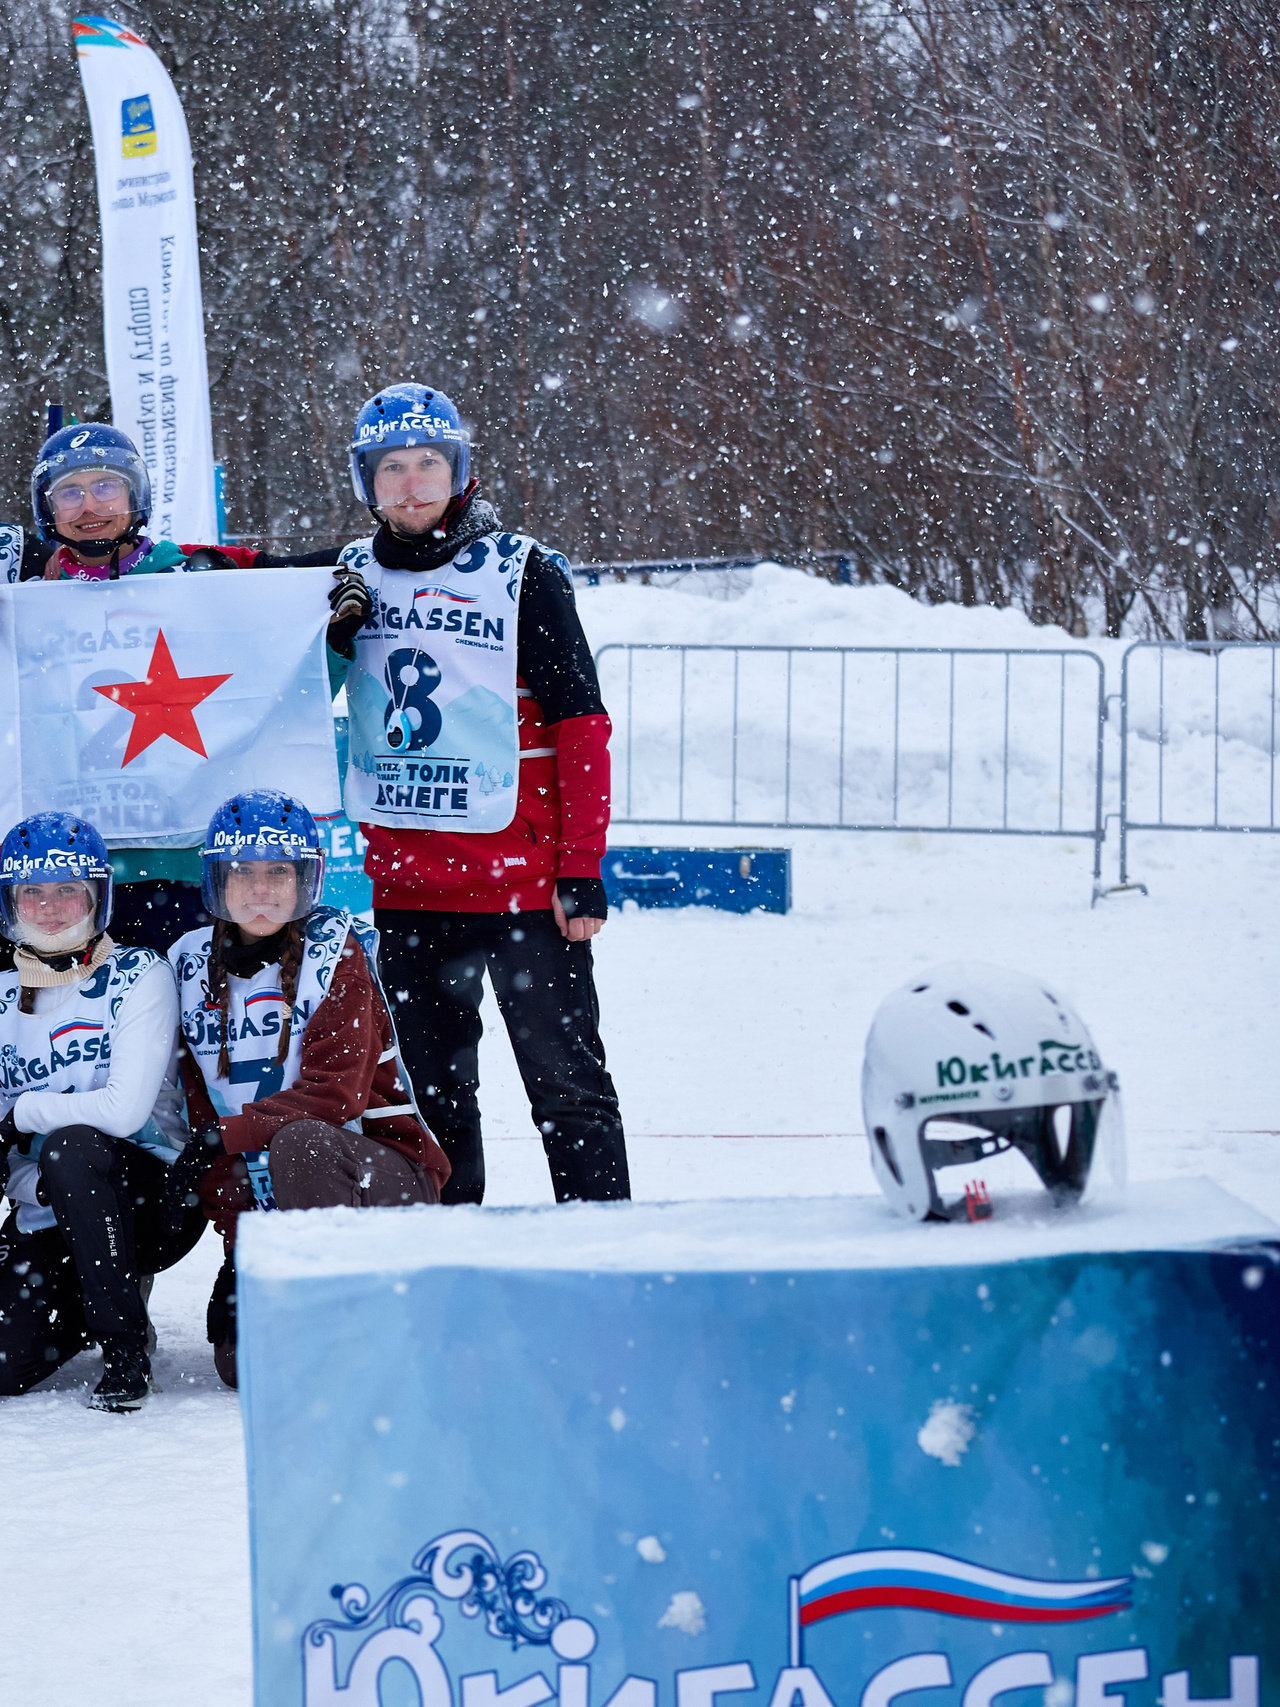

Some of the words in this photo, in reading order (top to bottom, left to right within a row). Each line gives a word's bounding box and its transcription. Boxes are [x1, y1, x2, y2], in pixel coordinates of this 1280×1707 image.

[127, 287, 153, 361] спорту
[384, 648, 442, 751] 8
[406, 764, 469, 784] ТОЛК
